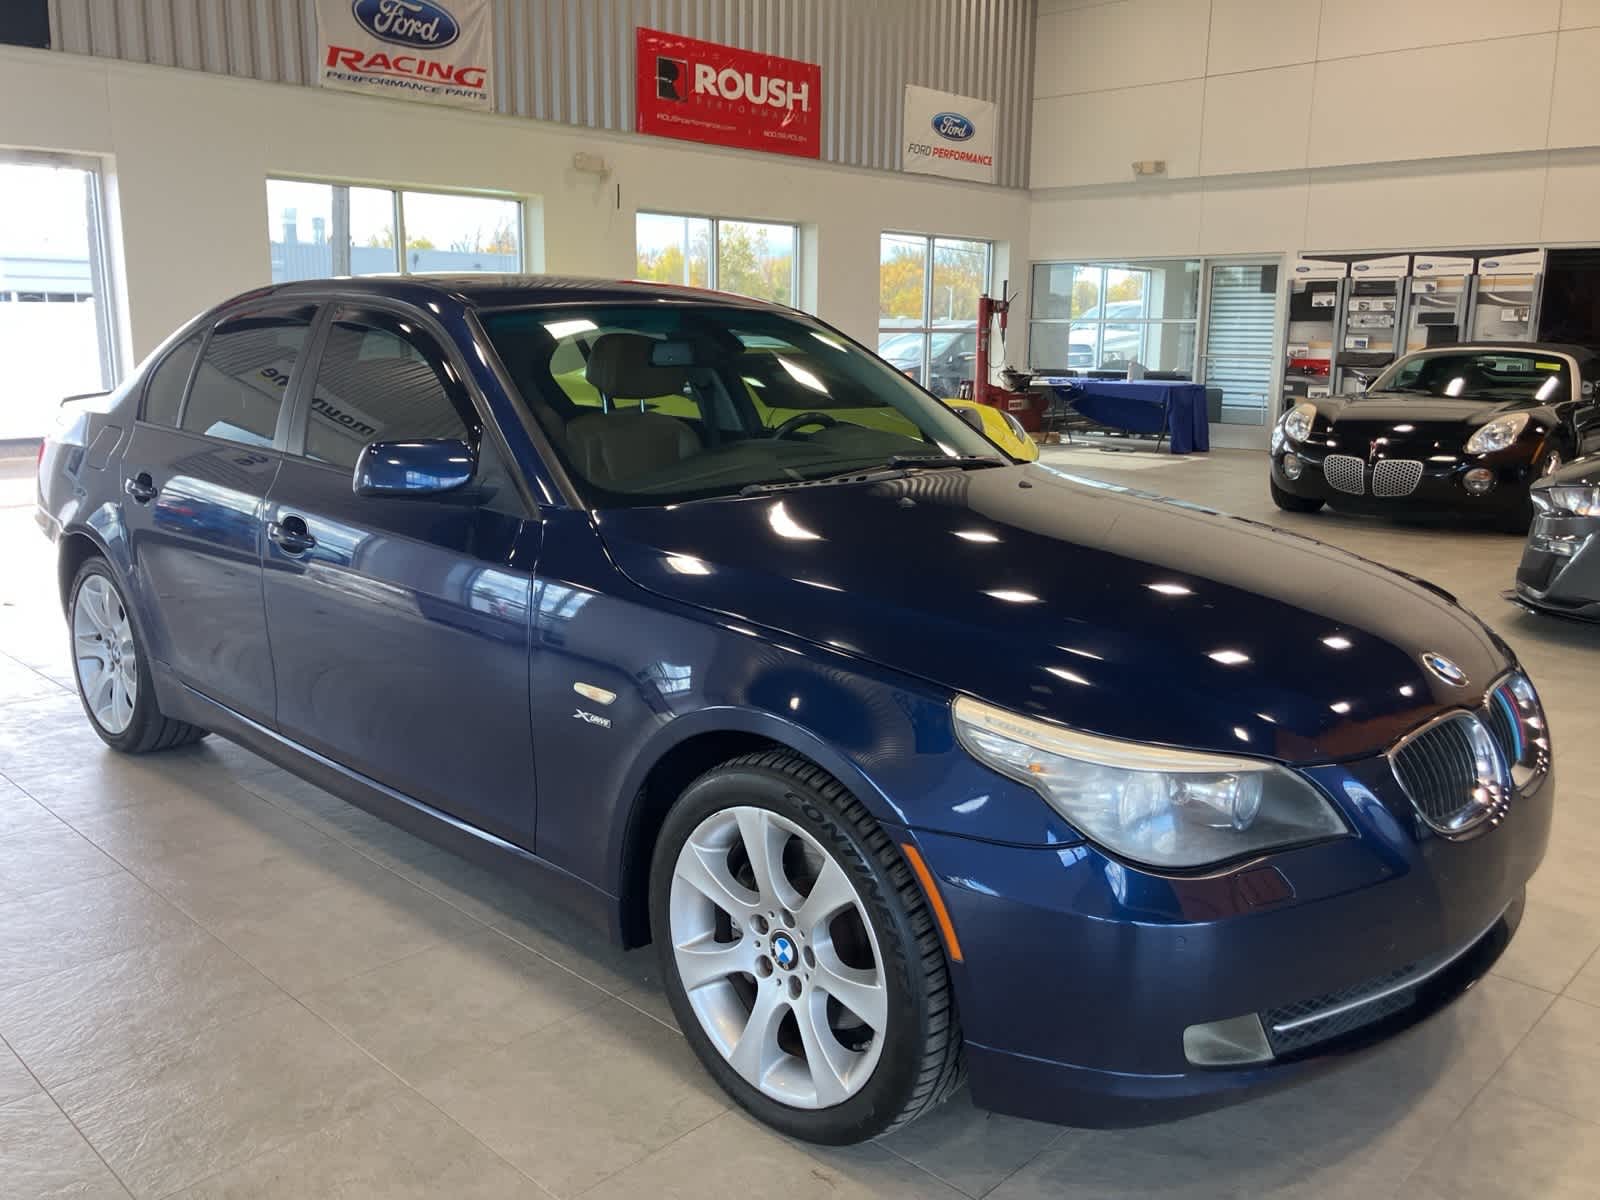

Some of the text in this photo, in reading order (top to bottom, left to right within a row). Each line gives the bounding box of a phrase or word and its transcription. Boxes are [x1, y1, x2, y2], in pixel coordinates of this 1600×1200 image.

[374, 0, 440, 43] Ford
[326, 44, 487, 89] RACING
[326, 71, 488, 101] PERFORMANCE PARTS
[694, 63, 809, 113] ROUSH
[940, 116, 967, 137] Ford
[908, 143, 993, 167] FORD PERFORMANCE
